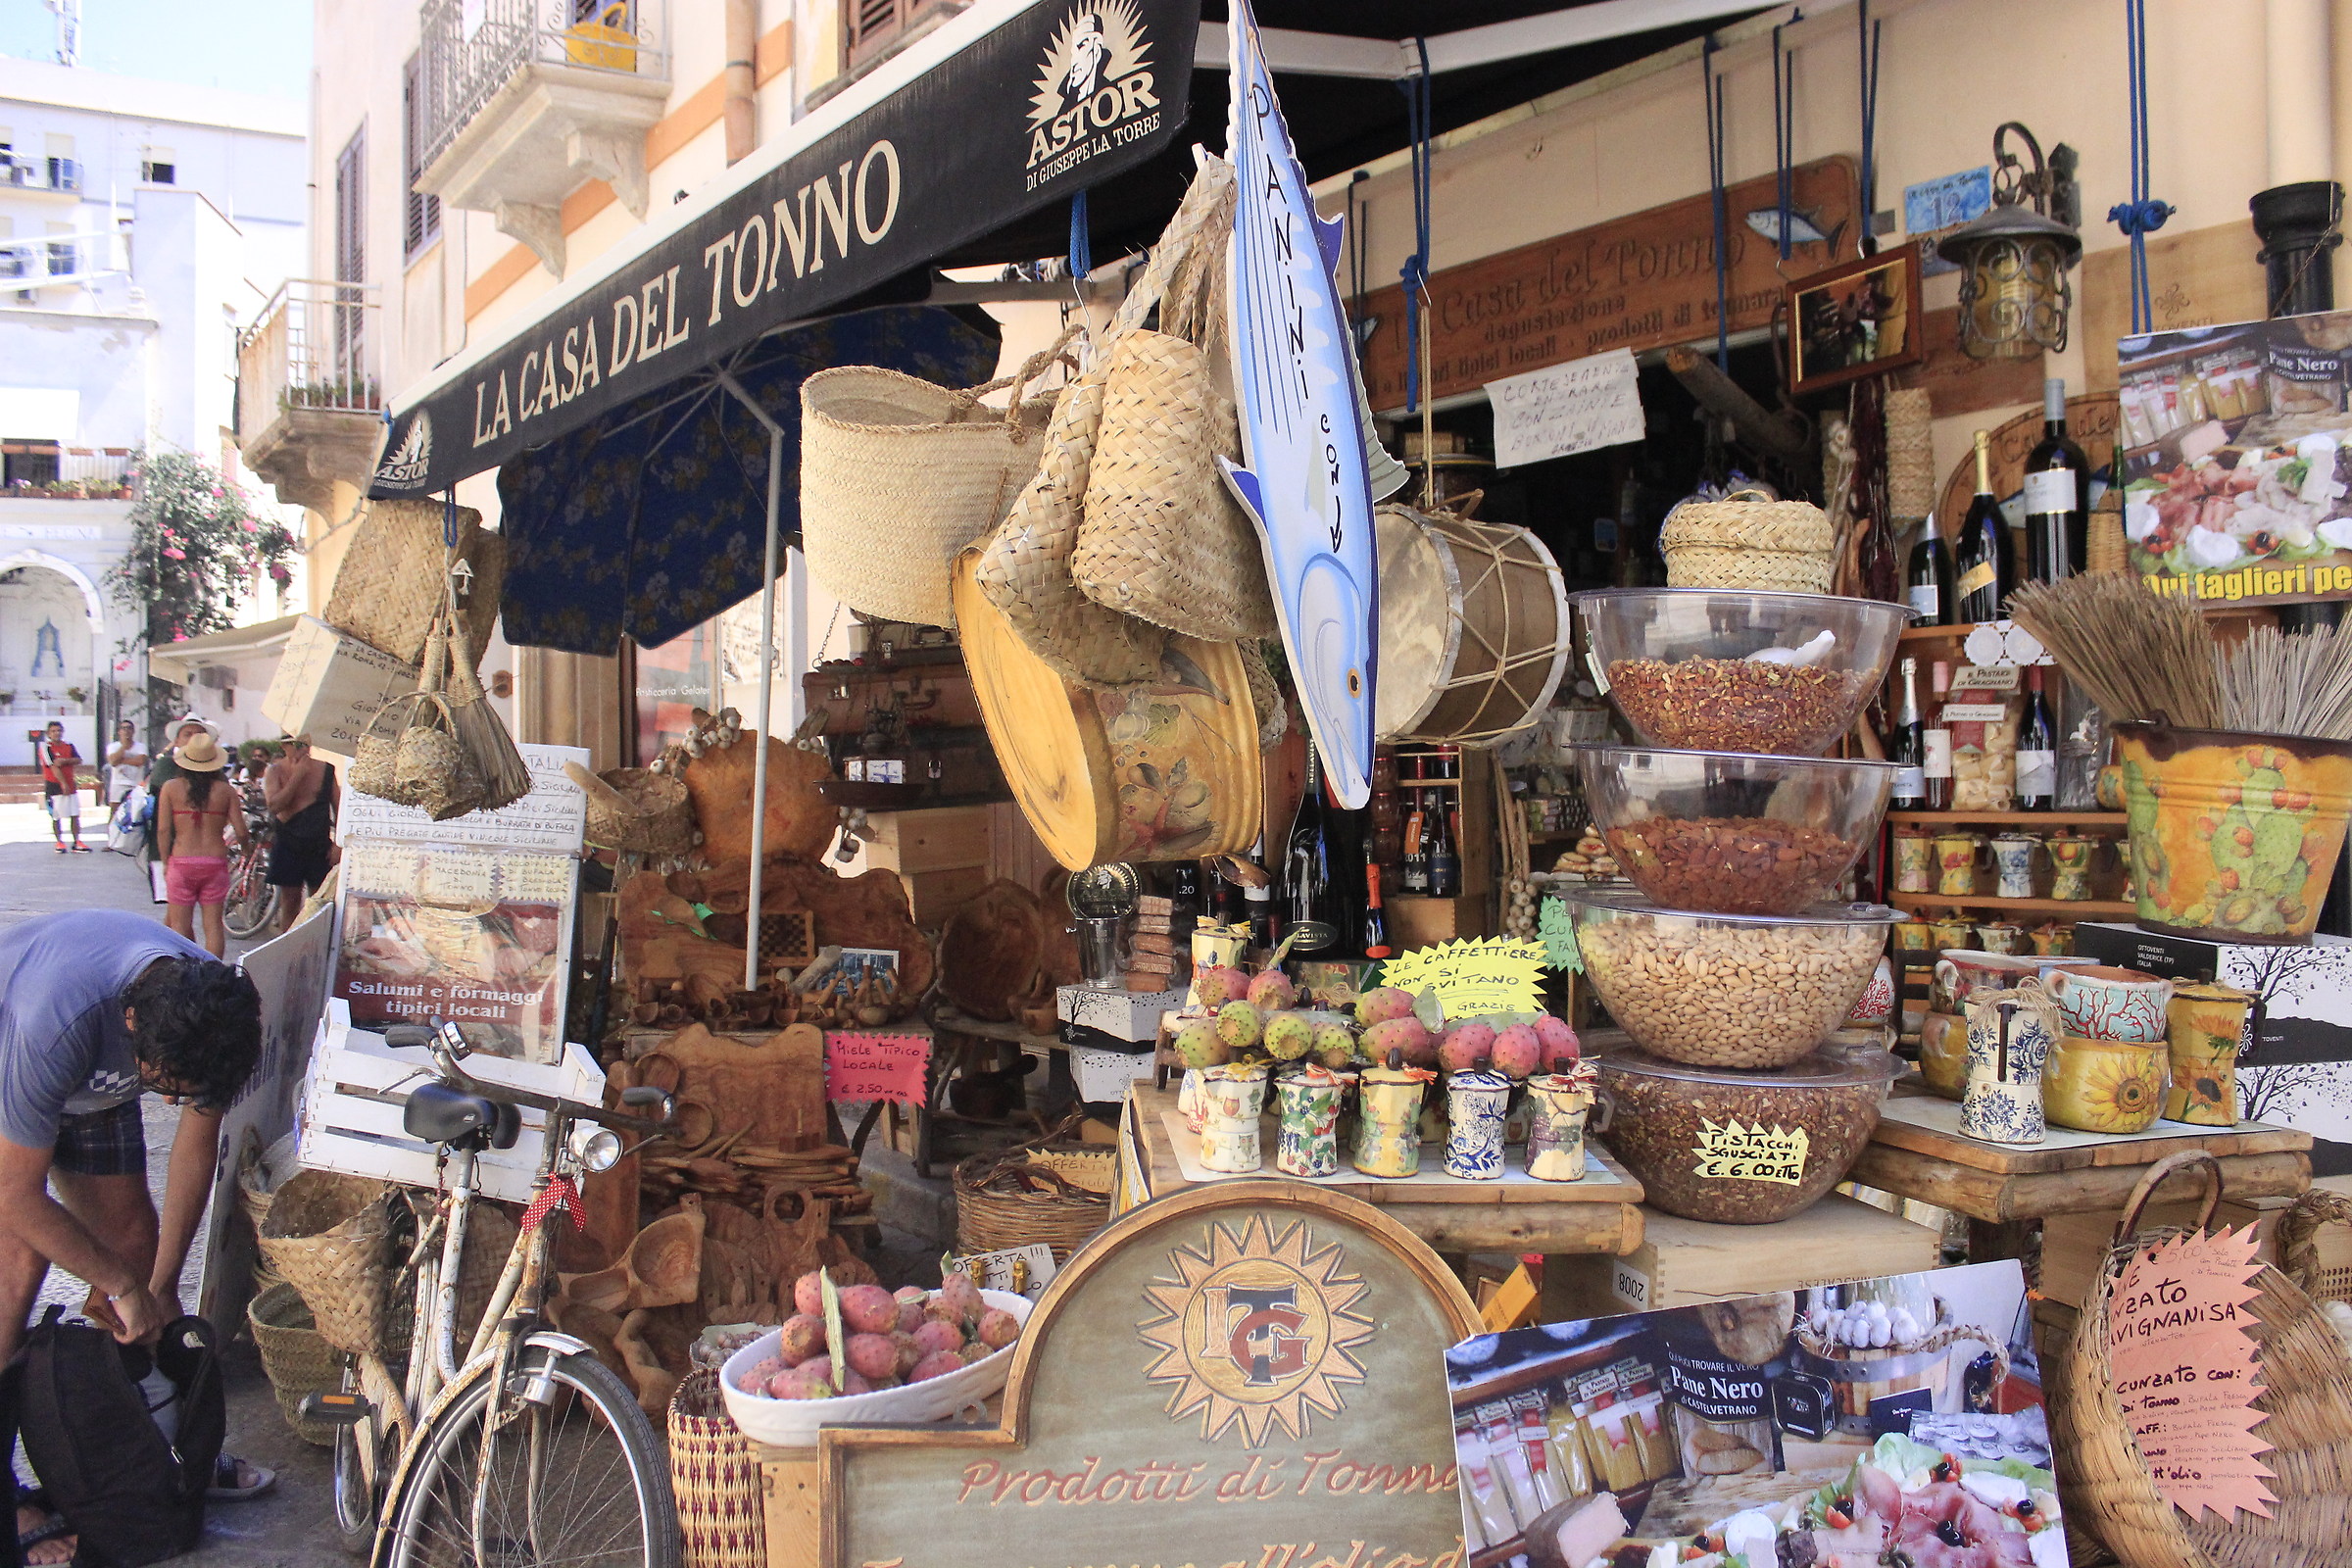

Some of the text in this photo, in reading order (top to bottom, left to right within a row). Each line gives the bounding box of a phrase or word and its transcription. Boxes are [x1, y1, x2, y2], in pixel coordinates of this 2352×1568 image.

[1025, 71, 1161, 171] ASTOR
[1026, 111, 1160, 192] DI GIUSEPPE LA TORRE
[1930, 191, 1961, 227] 12
[472, 138, 901, 449] LA CASA DEL TONNO
[1442, 280, 1526, 334] Casa
[1538, 237, 1598, 307] del
[1484, 295, 1626, 345] degustazione
[1508, 334, 1556, 365] locali
[1587, 309, 1663, 354] prodotti
[2269, 350, 2339, 371] Pane Nero
[374, 457, 429, 480] ASTOR
[2194, 564, 2306, 601] taglieri
[635, 686, 676, 697] Pasticceria
[389, 809, 428, 819] GIORNO
[1393, 960, 1411, 974] LE
[1423, 946, 1538, 965] CAFFETTIERE
[2137, 944, 2165, 955] OTTOVENTI
[2137, 952, 2175, 965] VALDERICE (TP)
[1393, 974, 1427, 989] NON
[348, 981, 544, 1005] Salumi e formaggi
[385, 1000, 507, 1019] tipici locali
[1457, 1001, 1516, 1012] GRAZIE
[837, 1044, 871, 1055] MIELE
[843, 1059, 895, 1071] LOCALE
[1709, 1129, 1801, 1150] PISTACCHI
[1706, 1147, 1796, 1161] SGUSCIATI
[1618, 1272, 1644, 1302] 2008
[1690, 1359, 1725, 1372] TROVARE
[1727, 1363, 1734, 1373] IL
[1670, 1365, 1706, 1397] Pane
[1709, 1377, 1764, 1399] Nero
[1681, 1395, 1757, 1415] di CASTELVETRANO
[956, 1455, 1211, 1507] Prodotti
[1215, 1454, 1287, 1503] di
